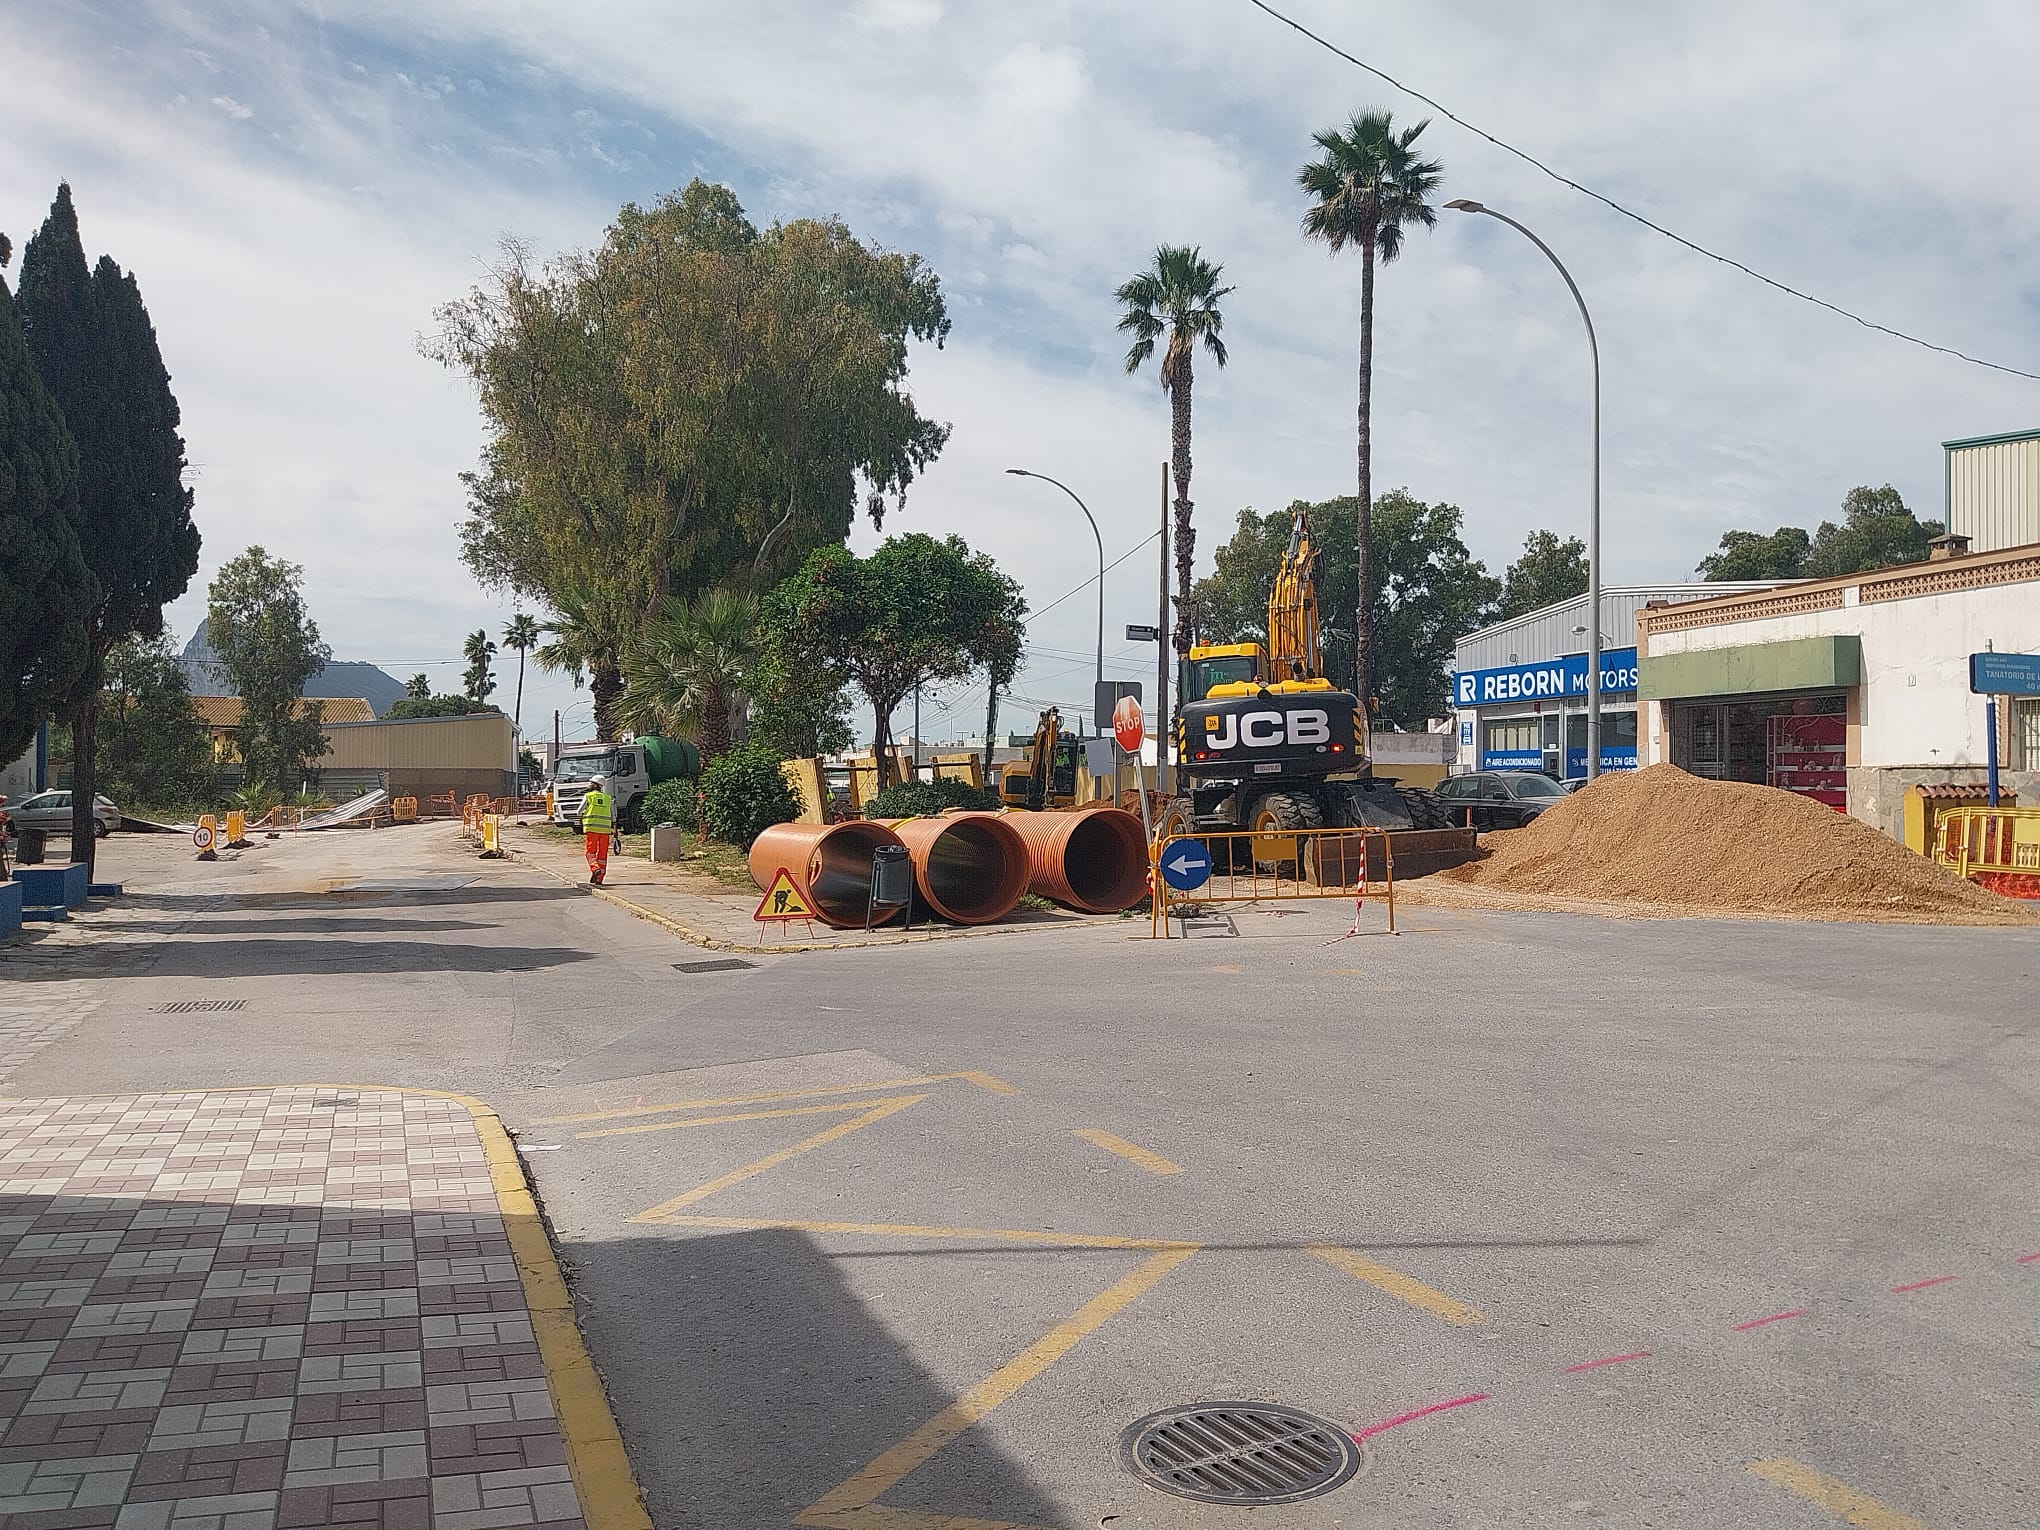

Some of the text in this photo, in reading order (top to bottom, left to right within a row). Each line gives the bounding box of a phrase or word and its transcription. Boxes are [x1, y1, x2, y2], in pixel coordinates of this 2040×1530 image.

[1985, 670, 2025, 680] TANATORIO
[2026, 672, 2036, 681] DE
[1484, 668, 1564, 700] REBORN
[1116, 716, 1140, 734] STOP
[1206, 709, 1330, 750] JCB
[1491, 757, 1542, 767] AIRE ACONDICIONADO
[1580, 757, 1613, 767] MEICA
[1613, 756, 1623, 766] EN
[197, 832, 209, 842] 10
